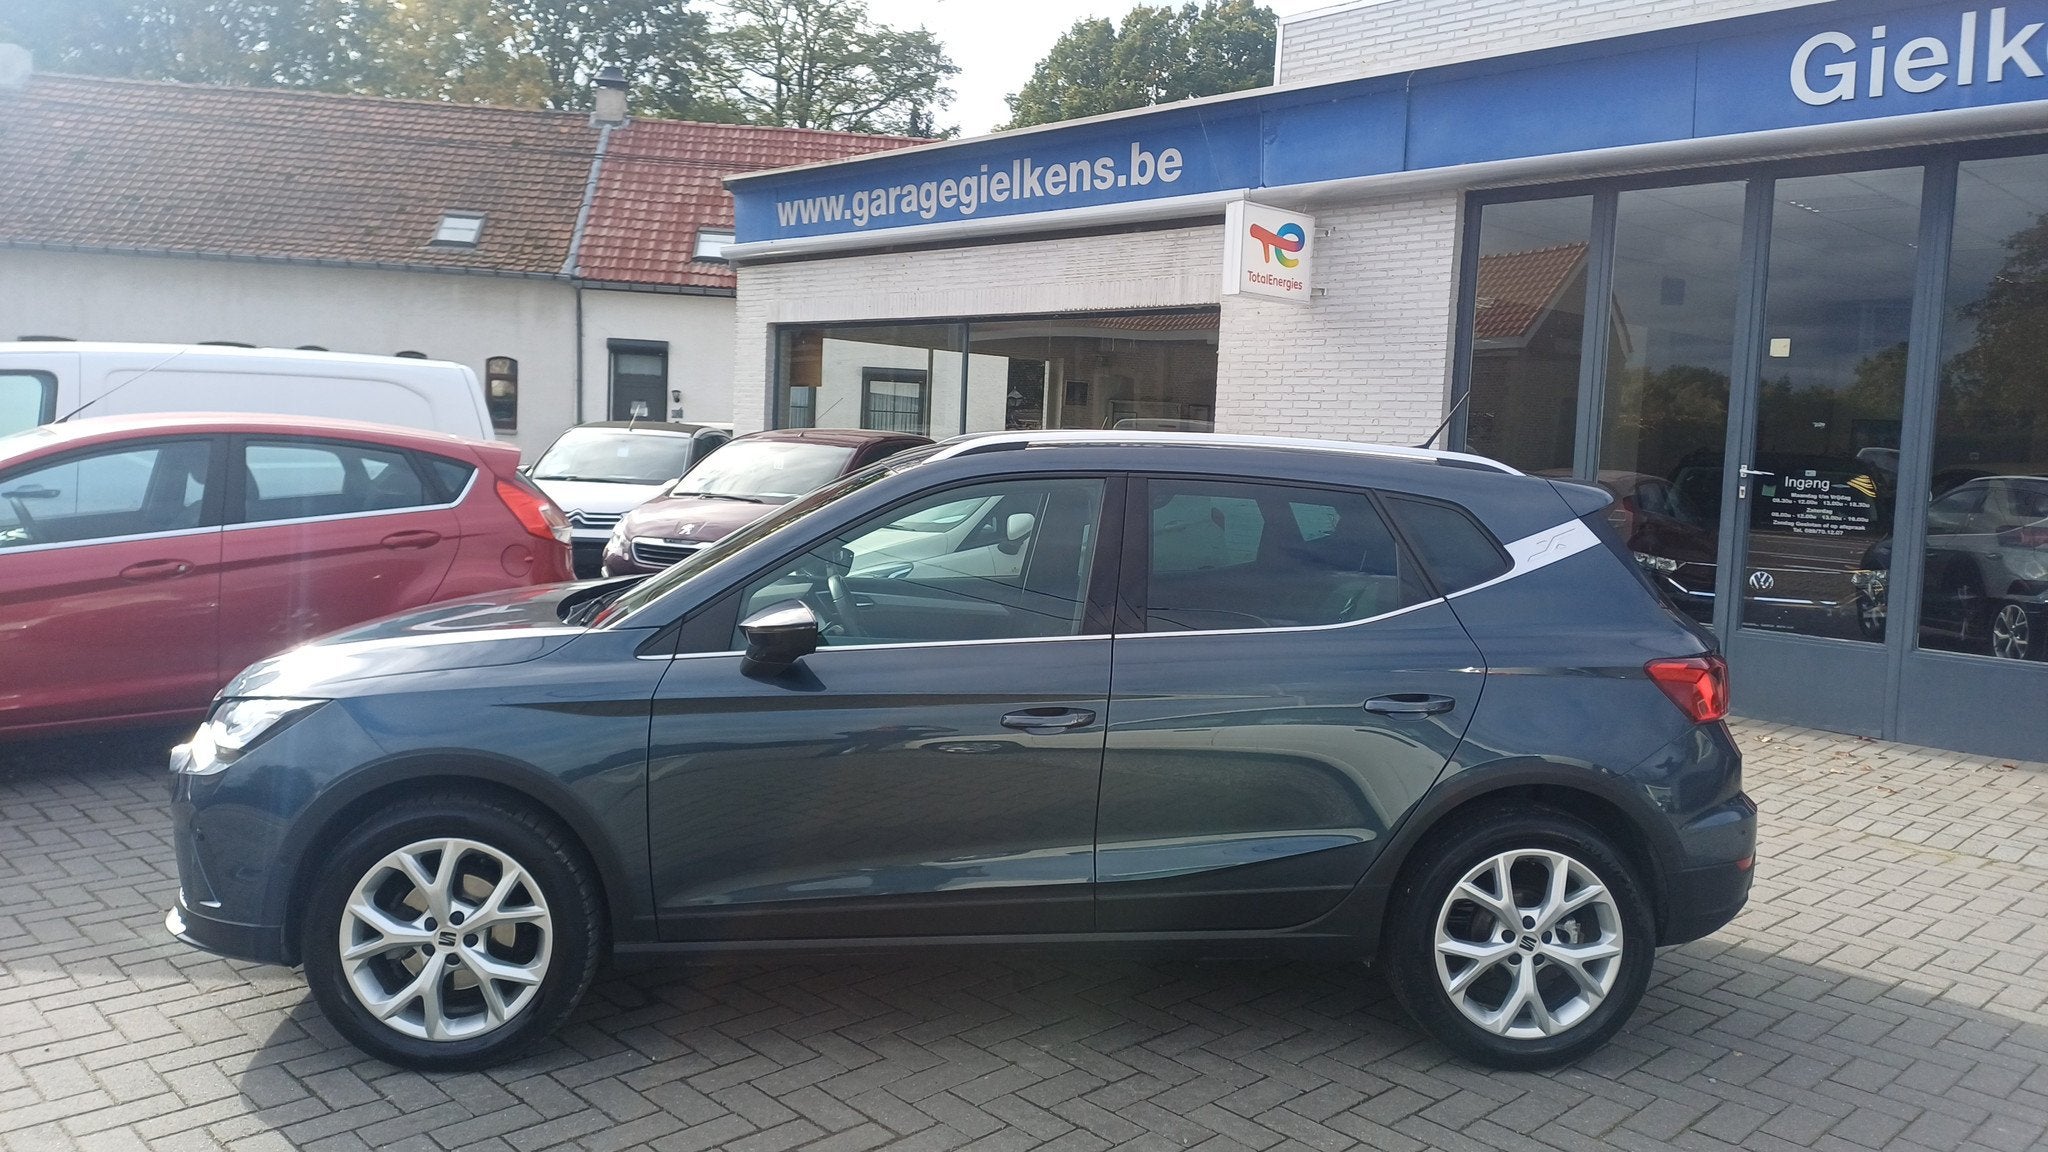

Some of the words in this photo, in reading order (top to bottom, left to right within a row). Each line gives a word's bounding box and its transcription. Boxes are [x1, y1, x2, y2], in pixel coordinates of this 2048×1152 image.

[1790, 7, 2048, 106] Gielk
[777, 142, 1184, 228] www.garagegielkens.be
[1247, 270, 1303, 291] TotalEnergies
[1785, 476, 1830, 491] Ingang
